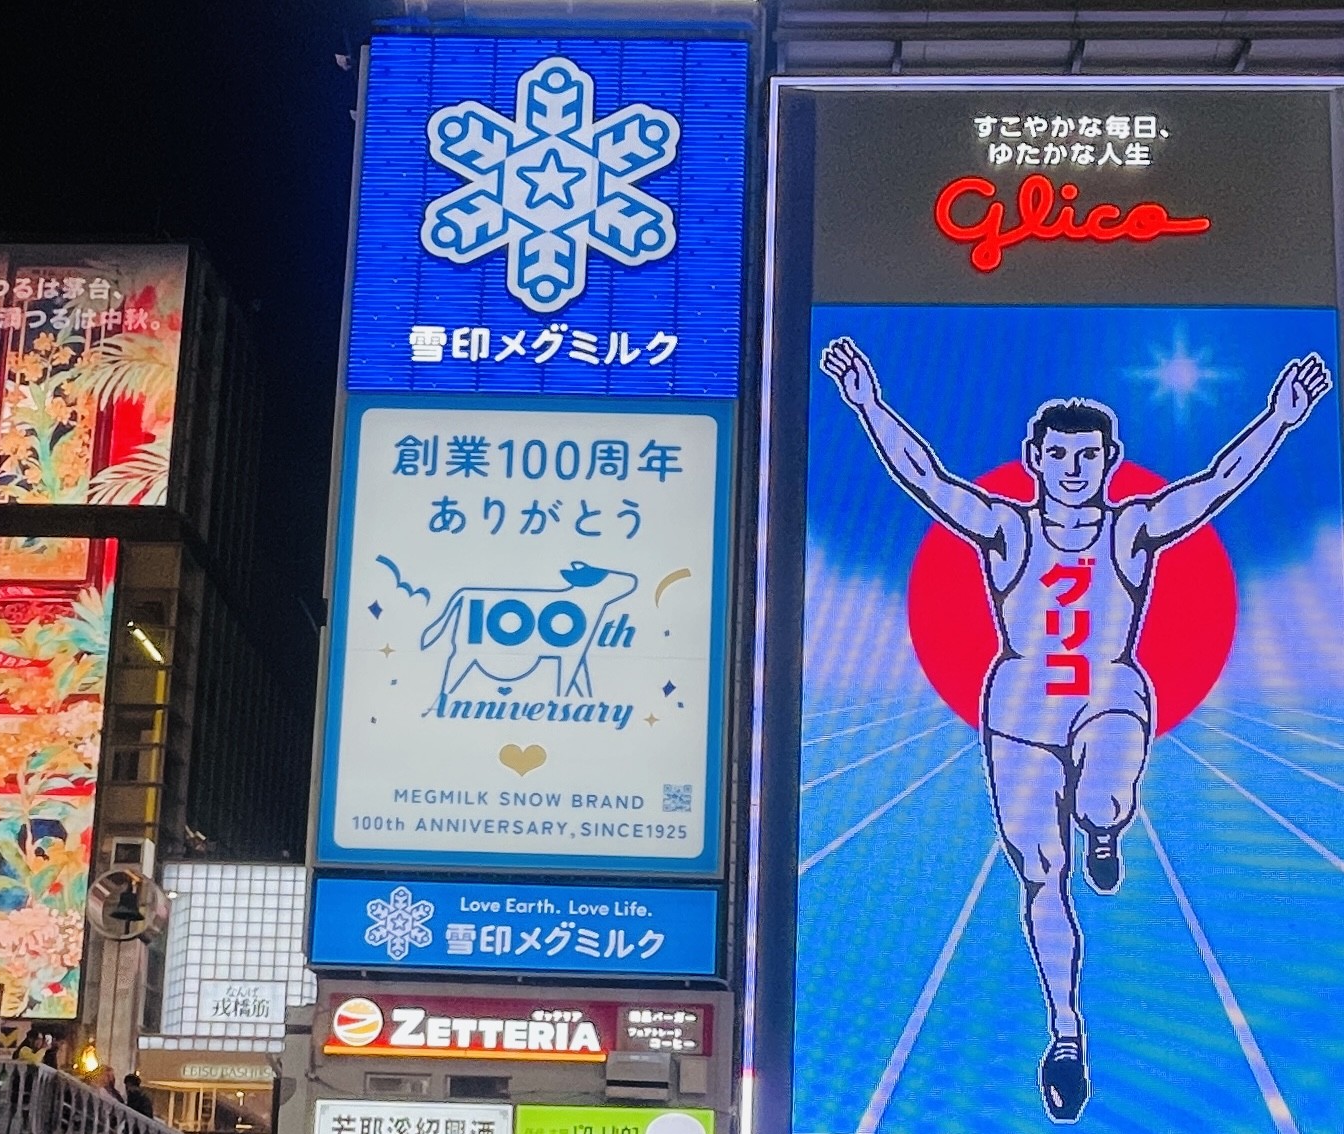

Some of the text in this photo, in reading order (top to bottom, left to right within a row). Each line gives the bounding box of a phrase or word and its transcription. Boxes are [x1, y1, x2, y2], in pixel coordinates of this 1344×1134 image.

[974, 115, 1171, 140] すこやかな毎日、
[989, 142, 1151, 167] ゆたかな人生
[409, 323, 678, 366] 雪印メグミルク
[392, 434, 684, 482] 創業100周年
[429, 495, 644, 539] ありがとう
[1039, 558, 1096, 697] グリコ
[421, 691, 634, 730] Anniversary
[394, 789, 644, 810] MEGMILK SNOW BRAND
[352, 815, 405, 831] 100th
[460, 897, 653, 918] Love Earth. Love Life.
[445, 921, 666, 959] 雪印メグミルク
[390, 1008, 602, 1052] ZETTERIA
